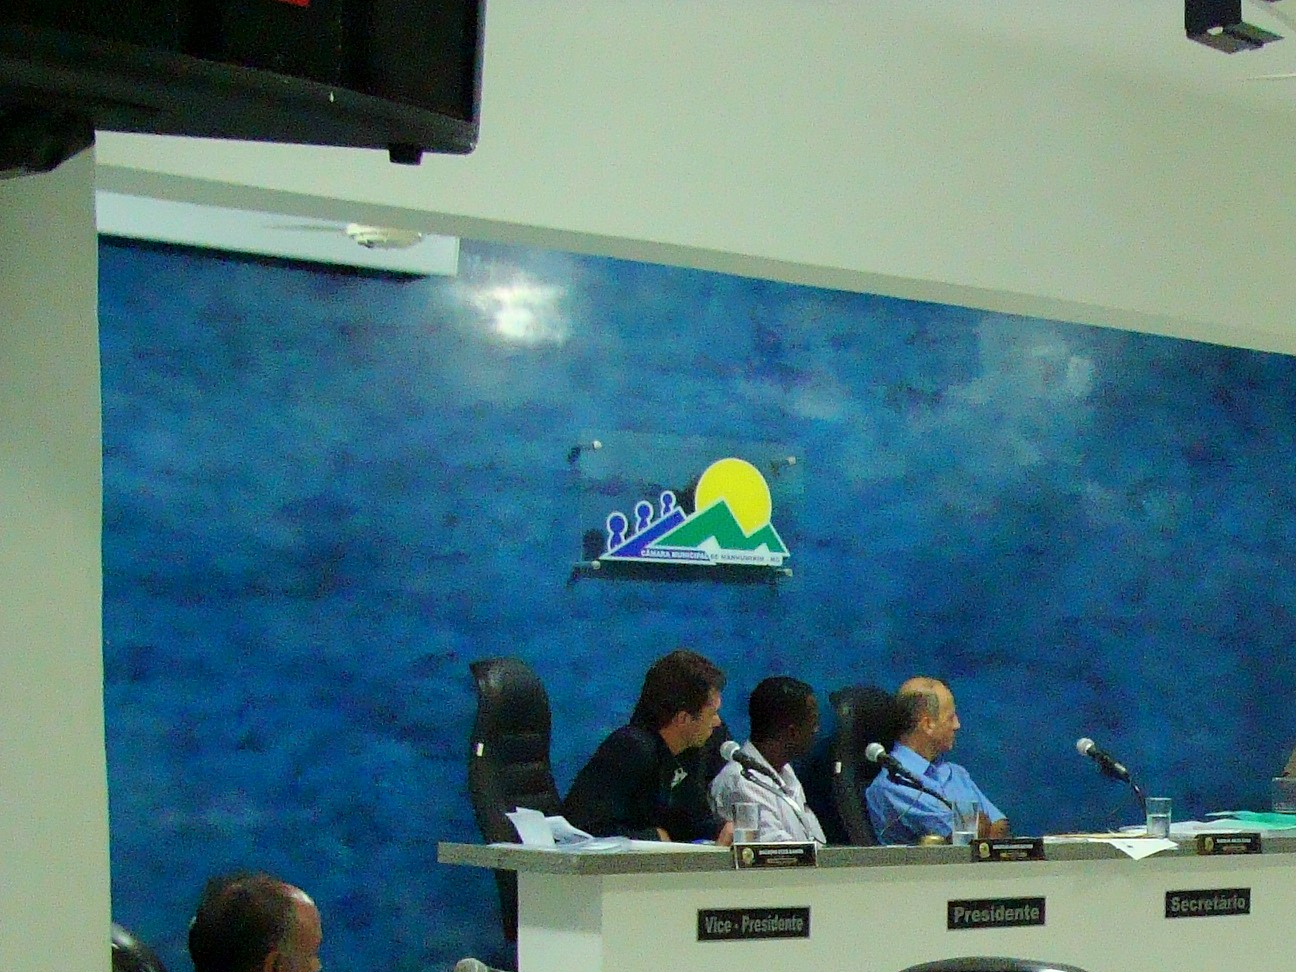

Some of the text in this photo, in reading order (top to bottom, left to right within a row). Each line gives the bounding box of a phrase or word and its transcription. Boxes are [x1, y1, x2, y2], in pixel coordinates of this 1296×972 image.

[1170, 894, 1246, 912] Secretário
[953, 904, 1040, 923] Presidente
[705, 916, 732, 934] Vice
[741, 914, 804, 934] Presidente
